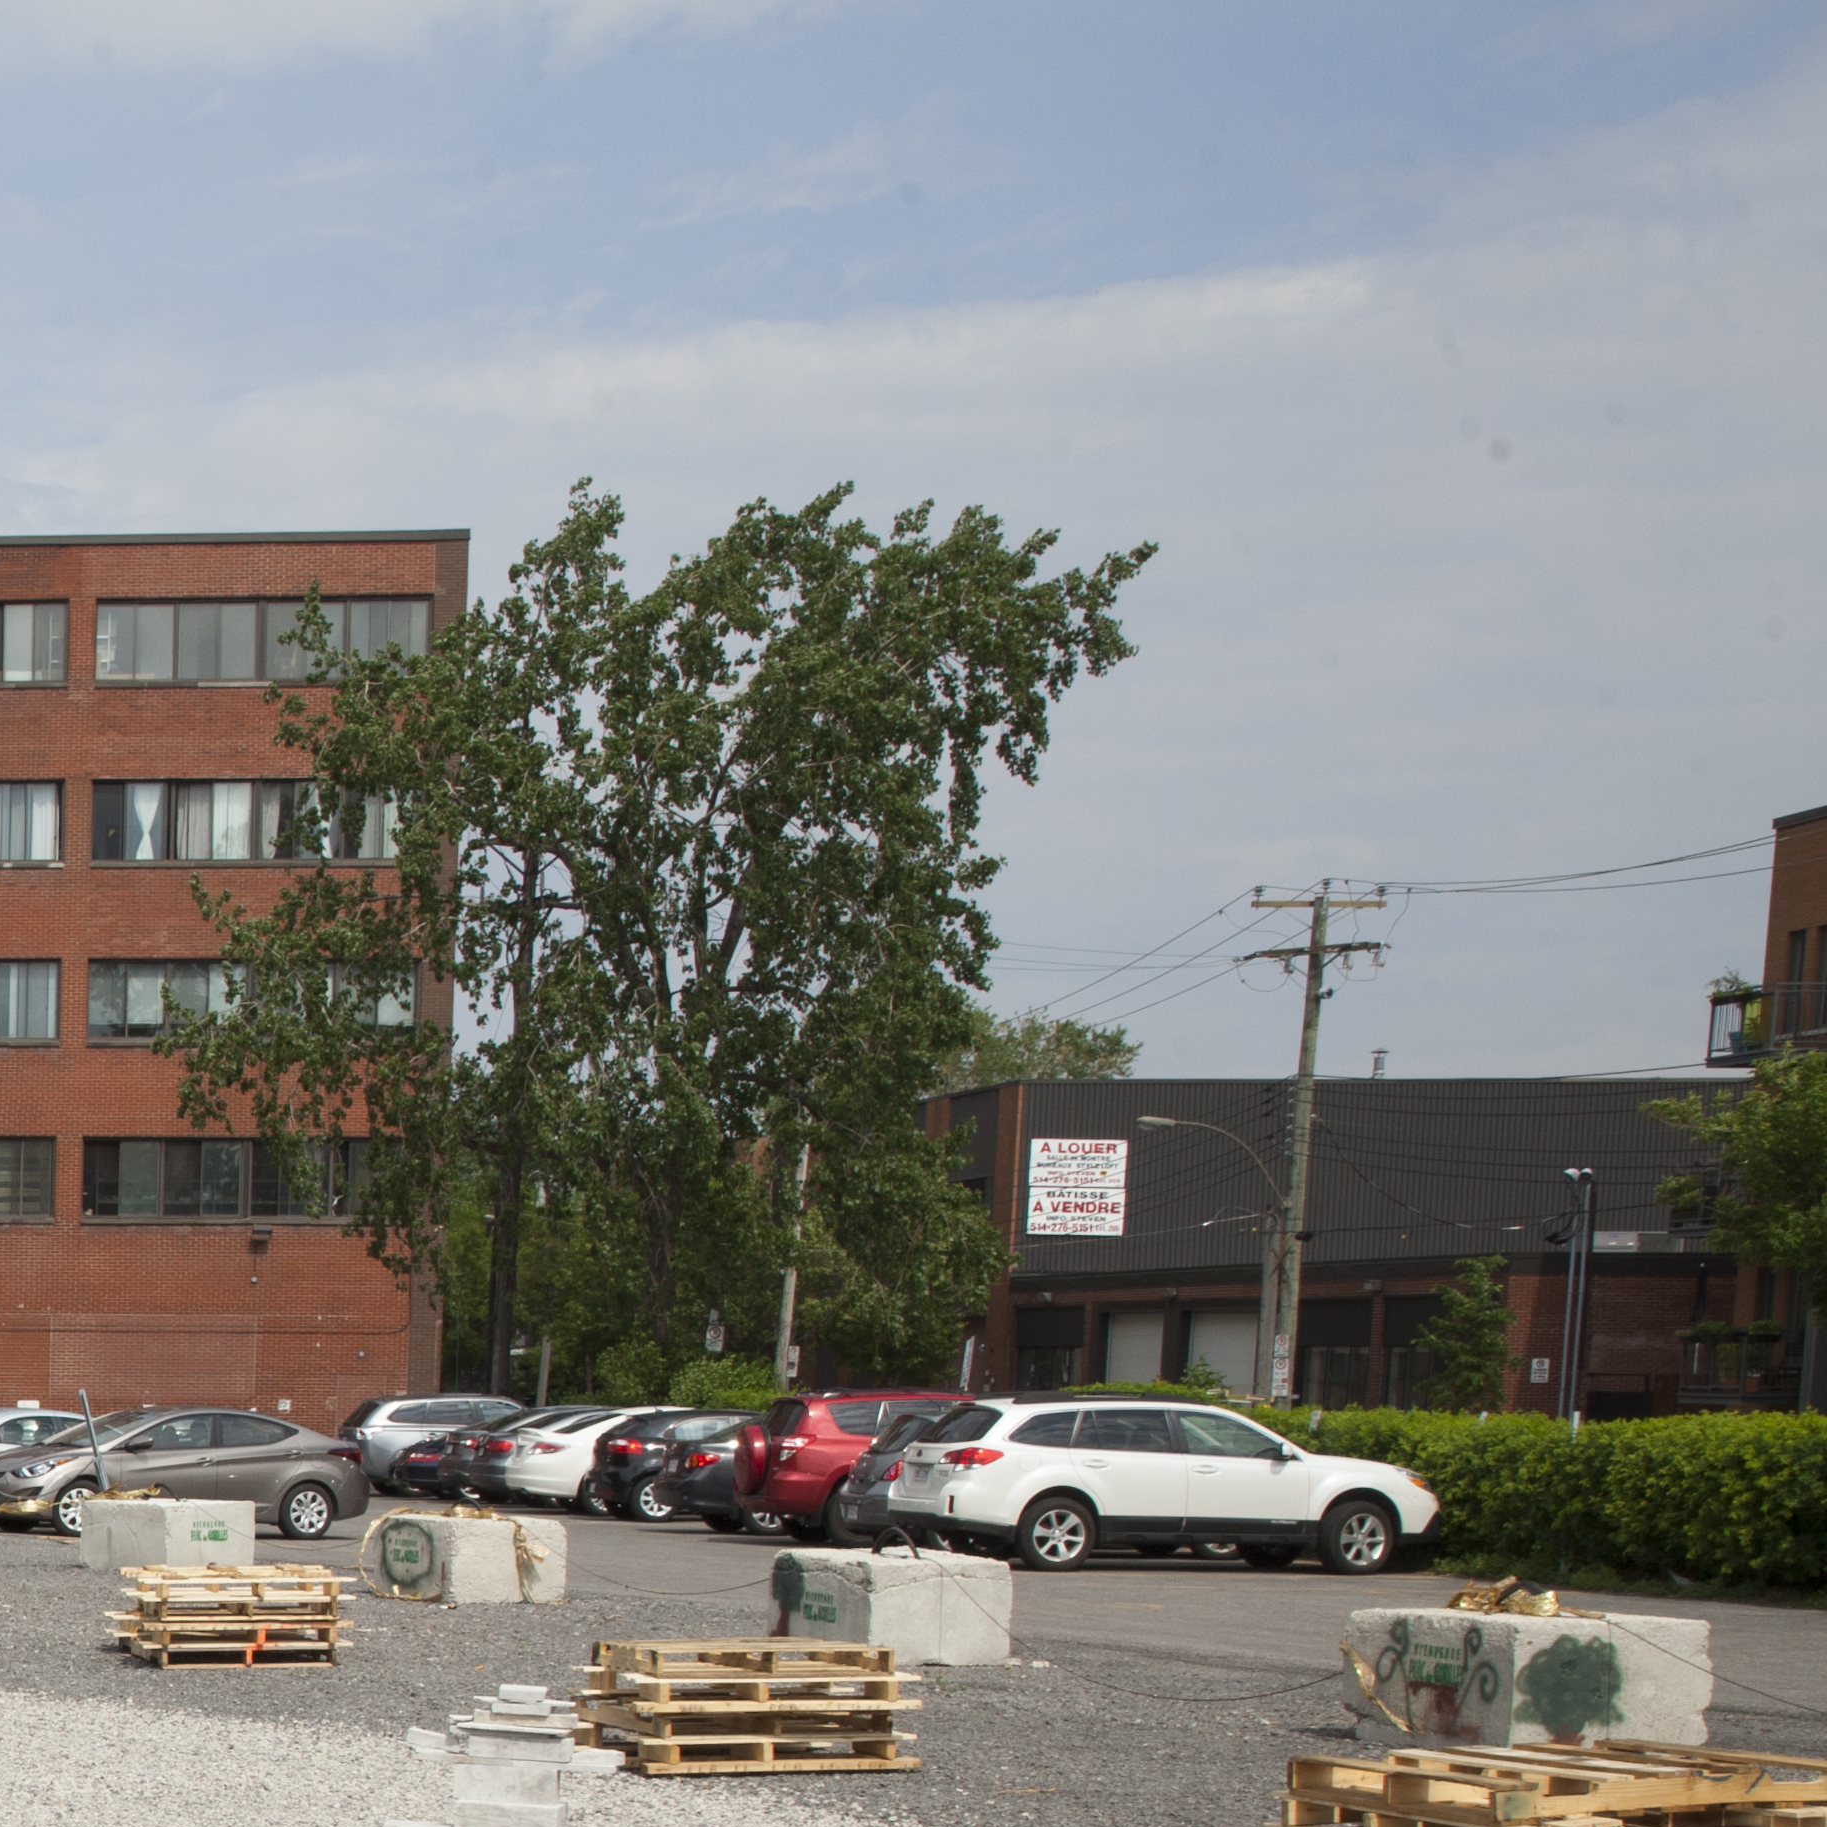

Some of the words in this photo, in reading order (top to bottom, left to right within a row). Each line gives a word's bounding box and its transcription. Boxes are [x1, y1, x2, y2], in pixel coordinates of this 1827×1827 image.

[1058, 1142, 1117, 1154] LOUER
[1050, 1201, 1121, 1214] VENDRE
[1030, 1222, 1093, 1233] 514-276-5151
